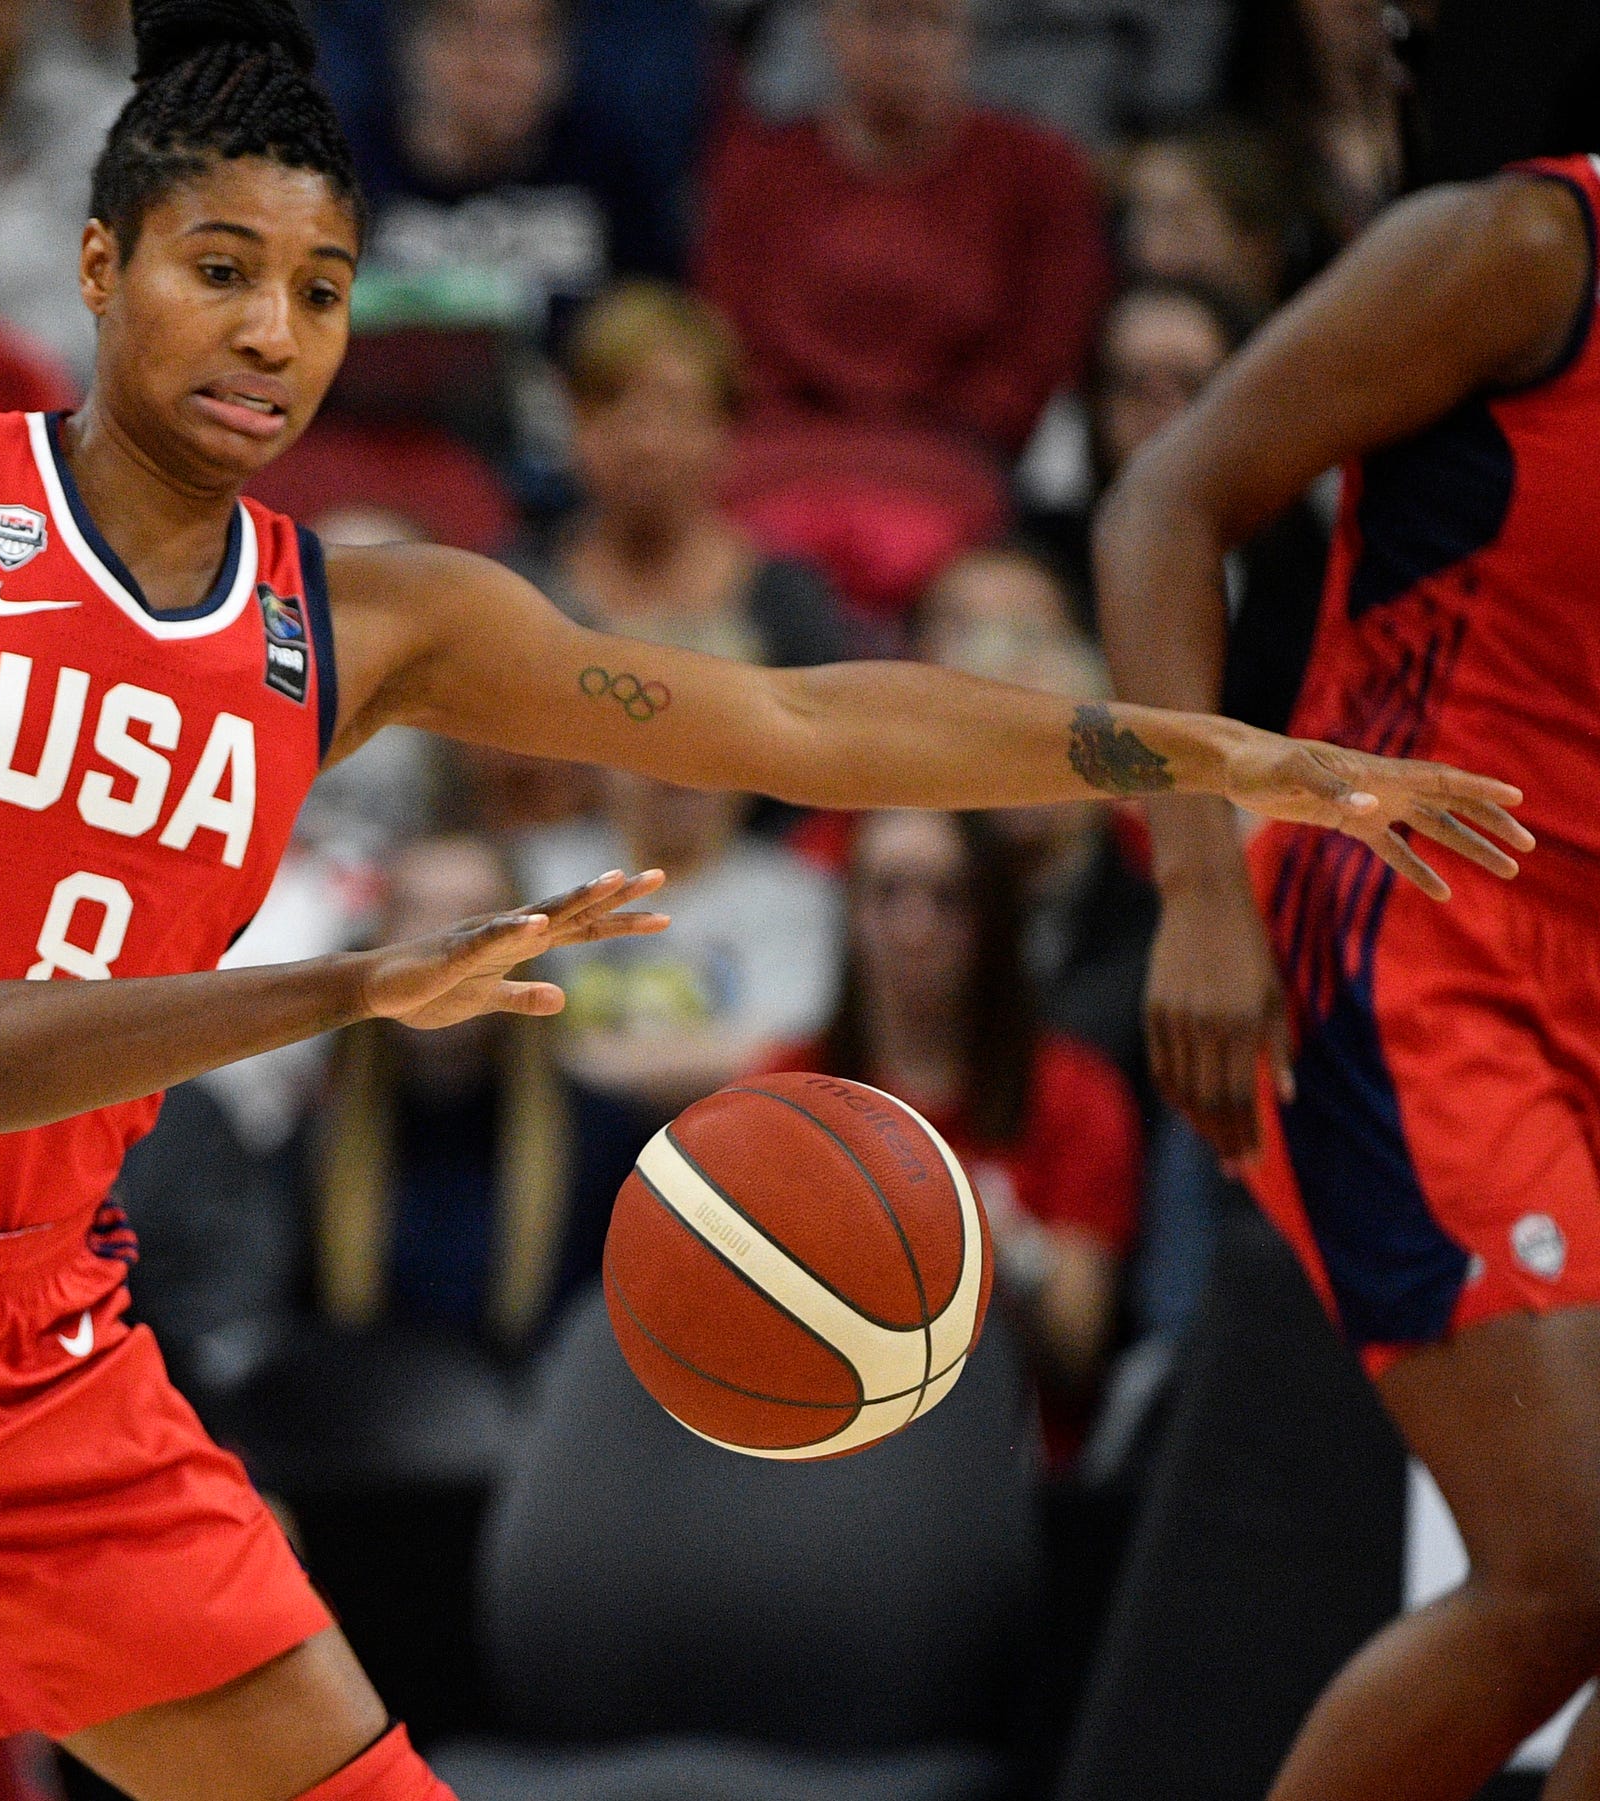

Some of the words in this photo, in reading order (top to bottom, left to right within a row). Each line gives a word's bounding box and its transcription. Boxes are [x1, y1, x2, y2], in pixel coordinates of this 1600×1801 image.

[0, 513, 34, 535] USA
[24, 870, 135, 981] 8
[806, 1079, 928, 1185] molten
